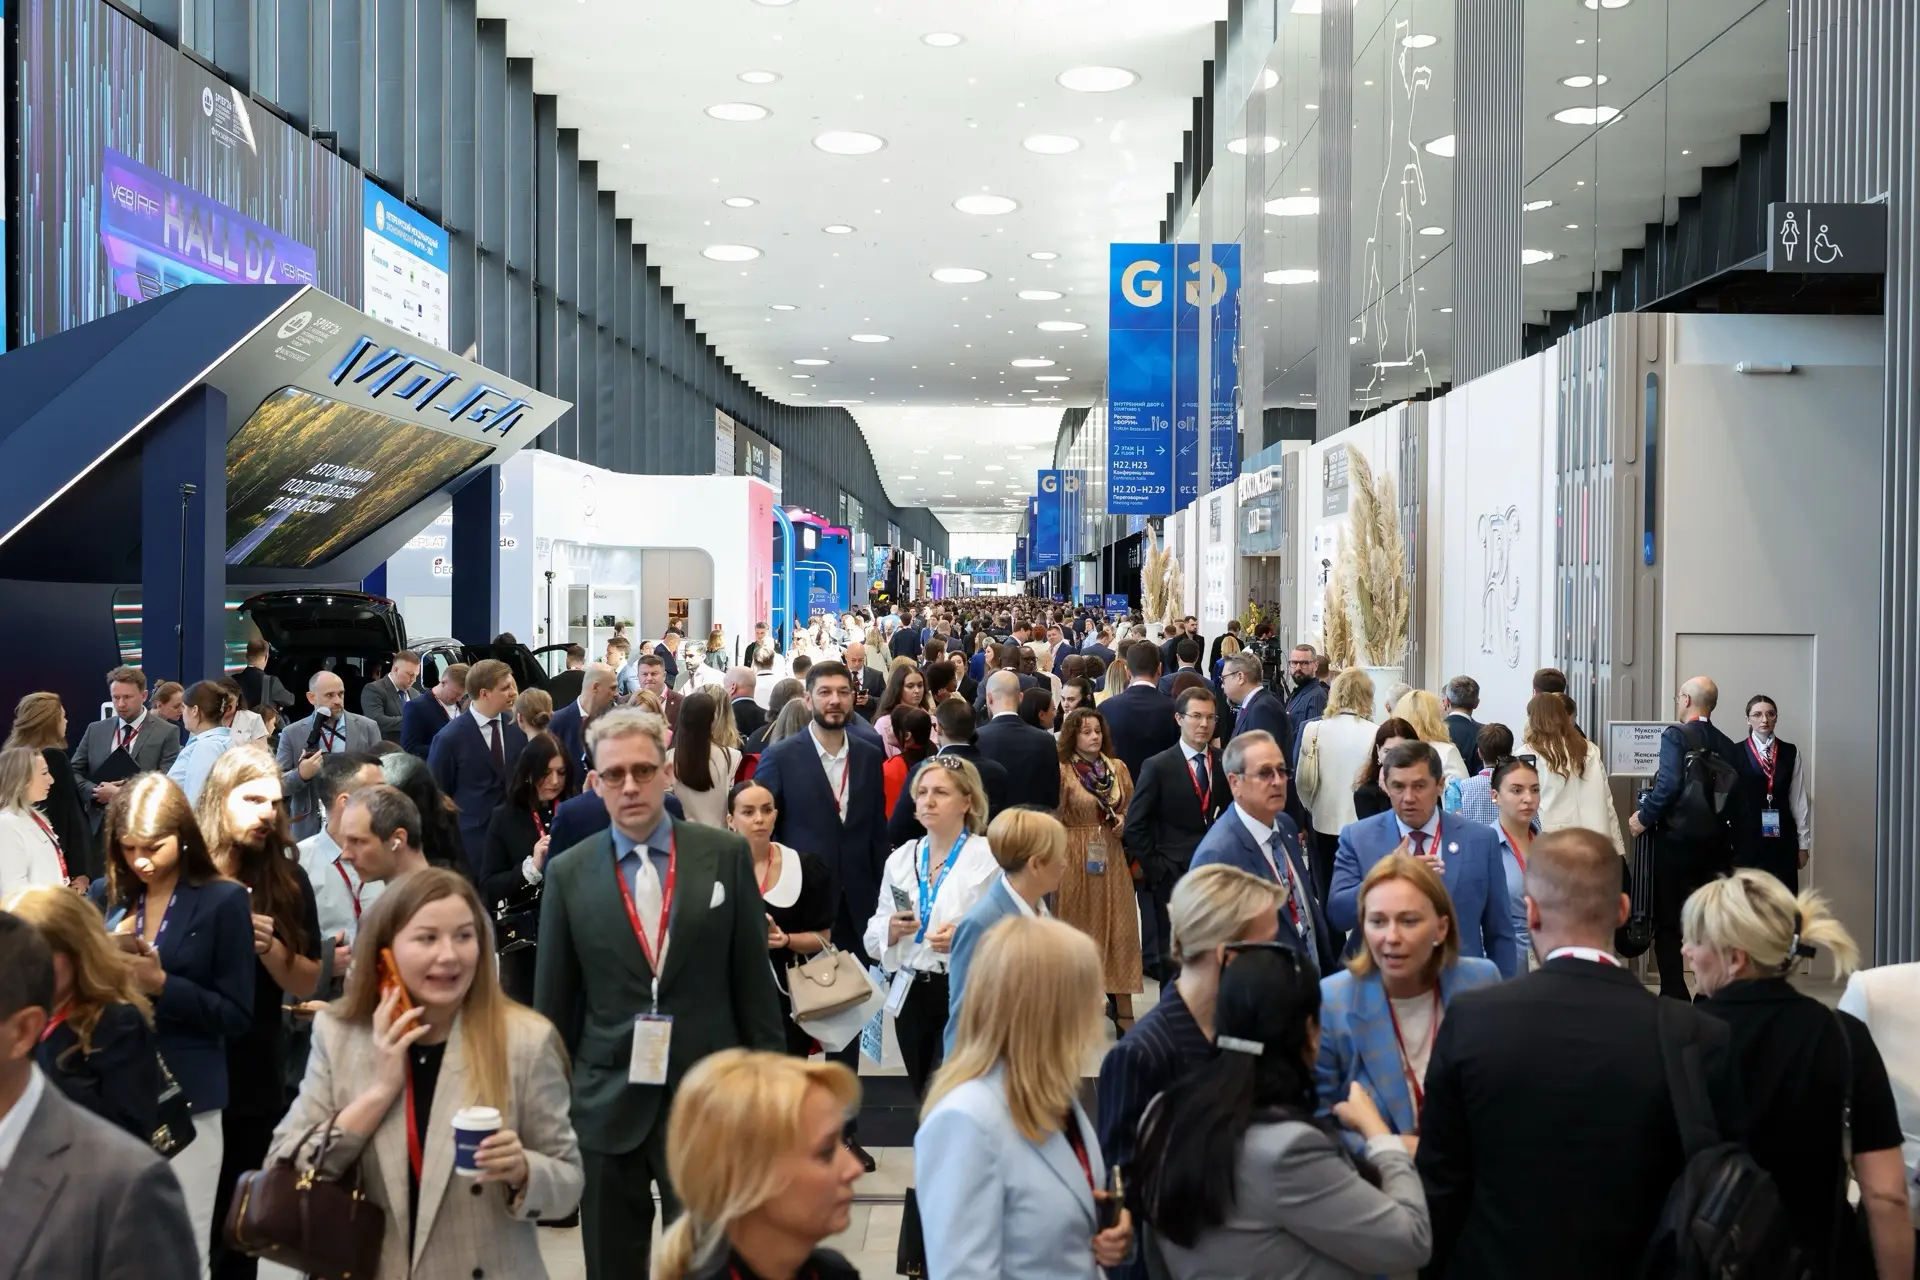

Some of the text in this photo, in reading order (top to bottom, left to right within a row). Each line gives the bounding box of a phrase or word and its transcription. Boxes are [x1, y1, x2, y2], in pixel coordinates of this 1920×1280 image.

[164, 190, 277, 284] HALL D2
[1121, 260, 1162, 308] G
[328, 336, 533, 438] VOLGA
[1113, 445, 1120, 455] 2
[305, 462, 376, 483] АВТОМОБИЛИ
[279, 478, 362, 499] ПОДГОТОВЛЕНЫ
[1041, 475, 1057, 493] G
[263, 497, 336, 514] ДЛЯ РОССИИ
[809, 593, 815, 603] 2
[811, 607, 826, 615] H22
